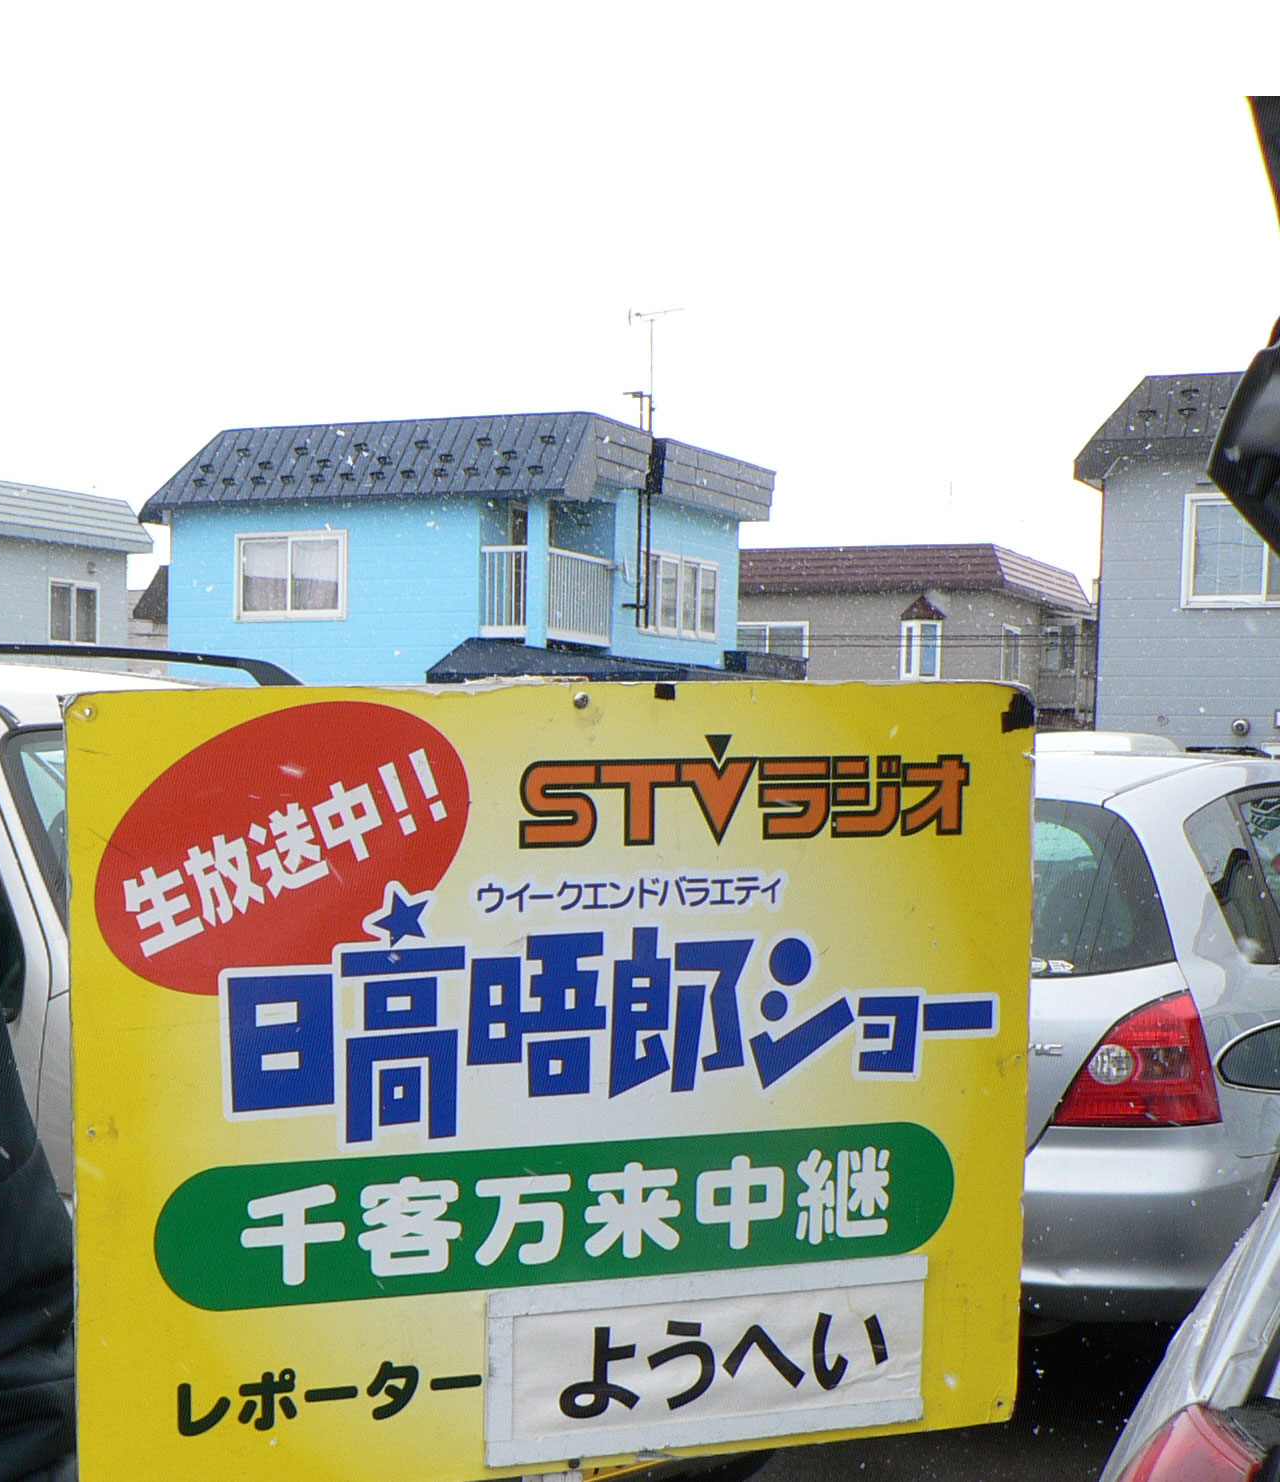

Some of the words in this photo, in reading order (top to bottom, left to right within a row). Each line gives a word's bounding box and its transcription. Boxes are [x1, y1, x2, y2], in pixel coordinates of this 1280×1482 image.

[123, 748, 448, 957] 生放送中!!
[477, 877, 782, 914] ウイークエンドバラエティ
[227, 926, 994, 1144] 日高晤郎ショー
[240, 1147, 891, 1286] 千客万来中継
[177, 1361, 483, 1437] レポーター
[558, 1312, 888, 1419] ようへい
